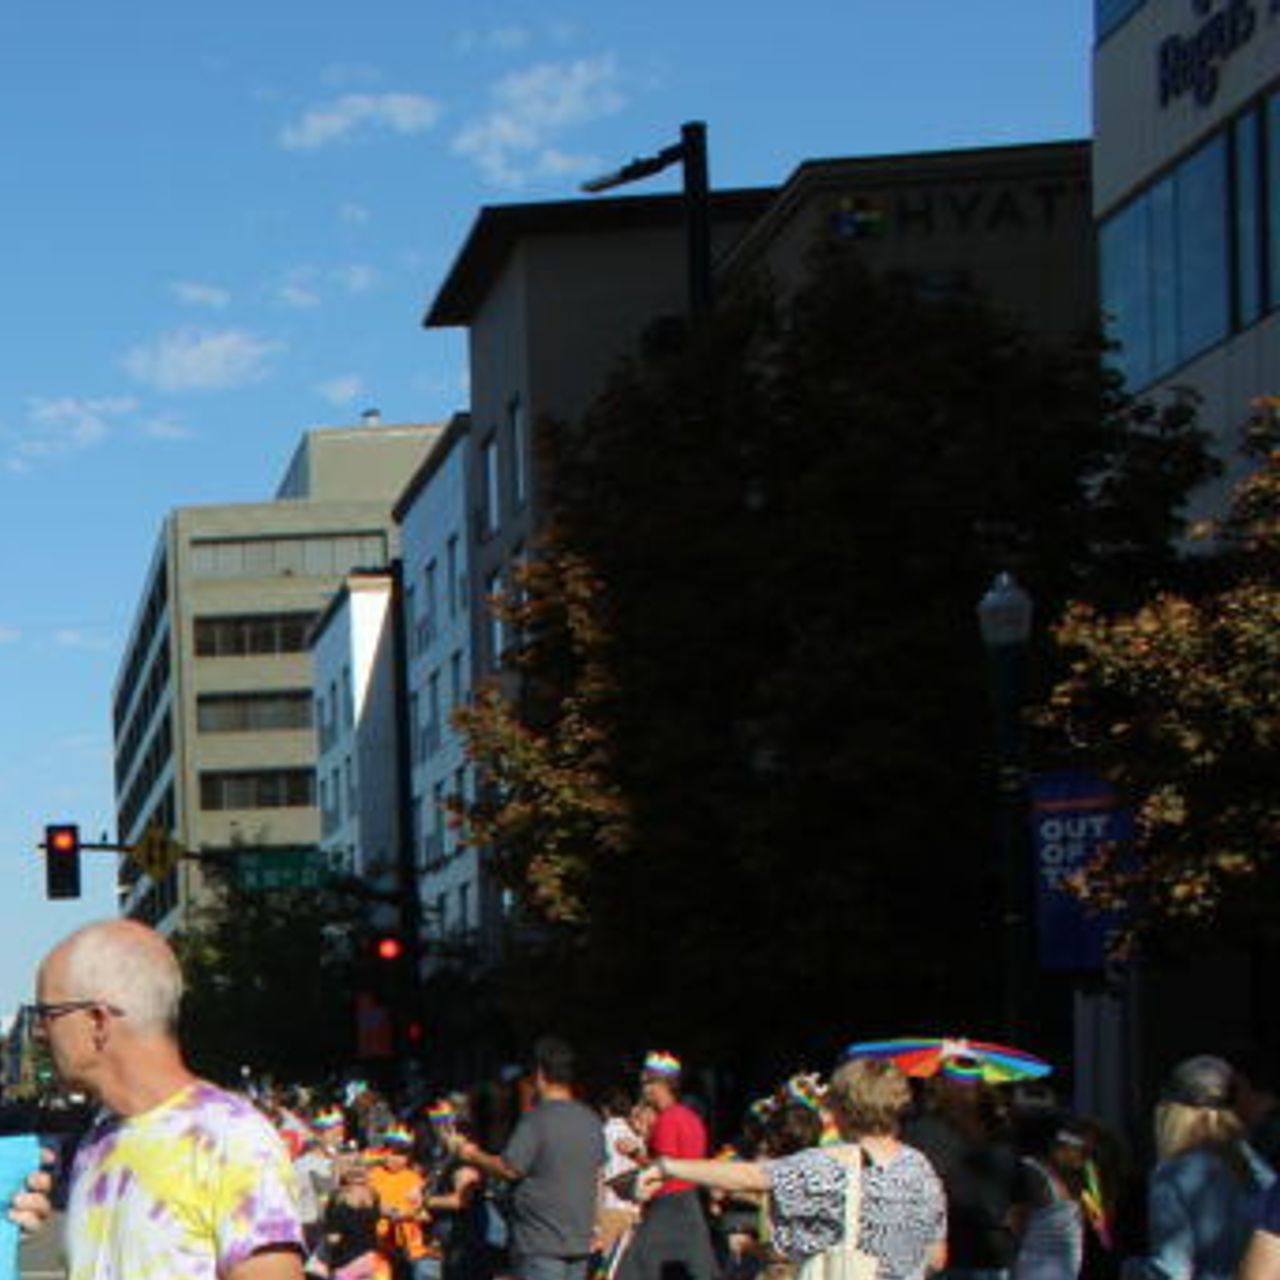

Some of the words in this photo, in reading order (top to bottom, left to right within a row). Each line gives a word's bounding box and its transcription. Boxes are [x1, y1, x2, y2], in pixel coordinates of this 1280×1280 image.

[897, 180, 1080, 234] HYAT
[1040, 815, 1107, 841] OUT
[1040, 842, 1086, 864] OF
